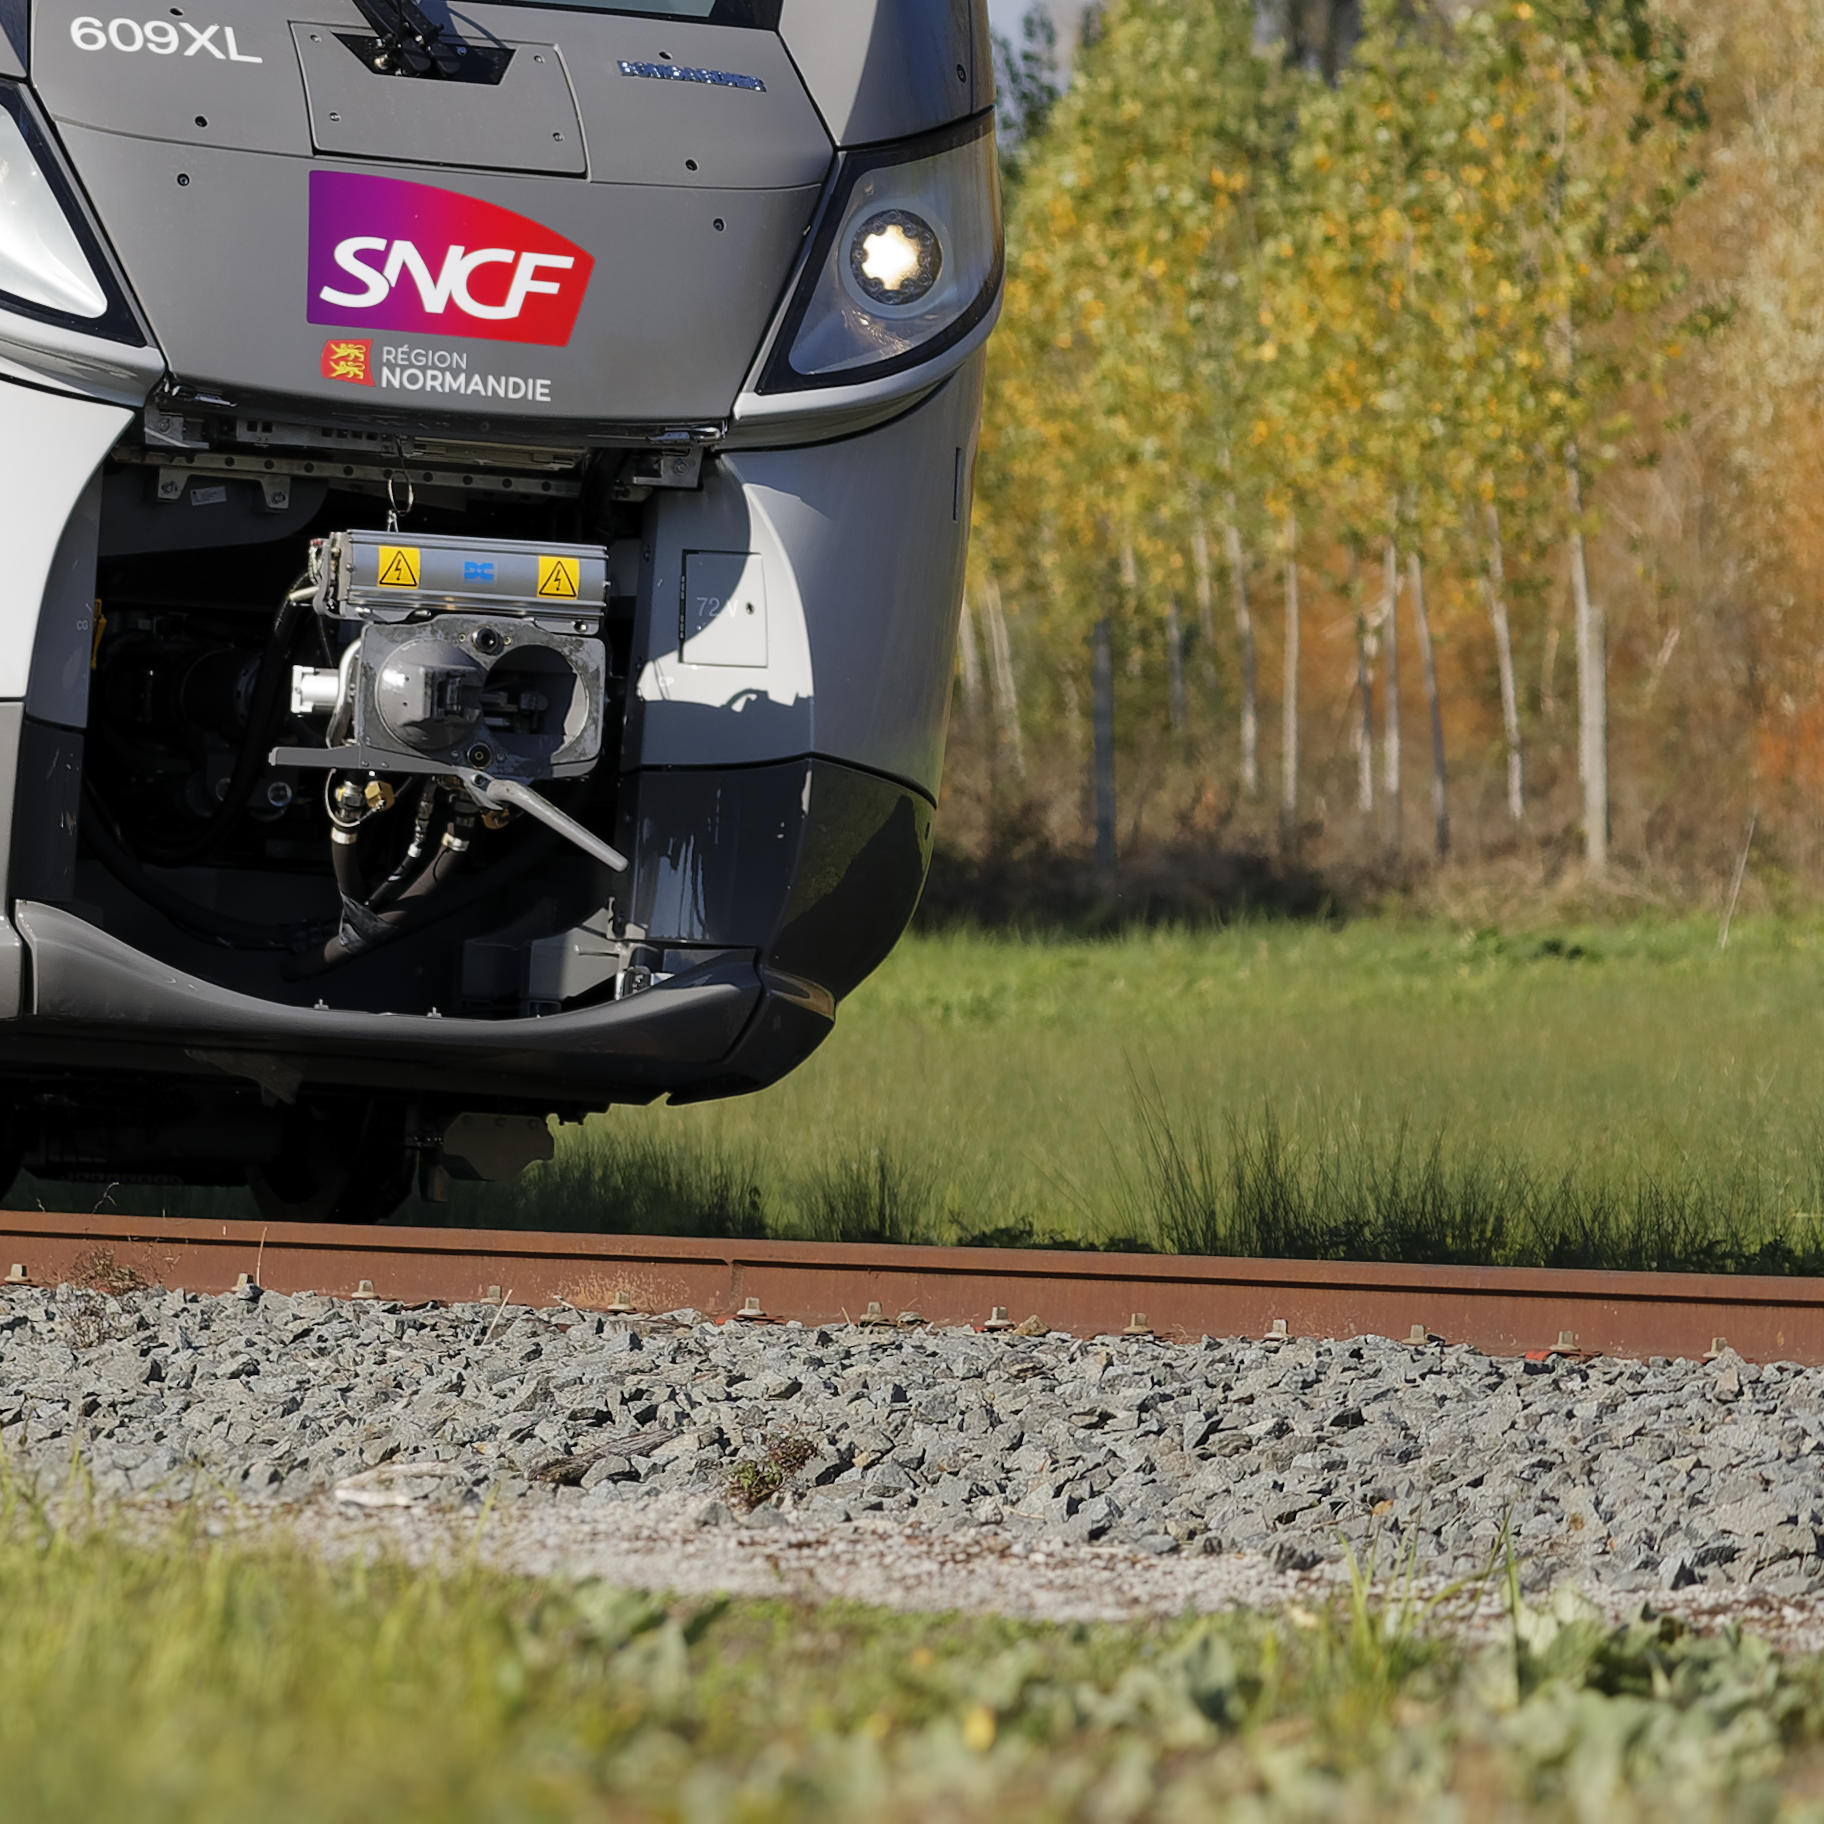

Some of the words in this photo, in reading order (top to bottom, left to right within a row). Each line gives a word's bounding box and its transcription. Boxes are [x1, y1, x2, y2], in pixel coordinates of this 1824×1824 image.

[70, 16, 263, 64] 609XL
[319, 236, 575, 320] SNCF
[382, 344, 467, 369] RÉGION
[381, 367, 551, 402] NORMANDIE
[696, 597, 720, 617] 72
